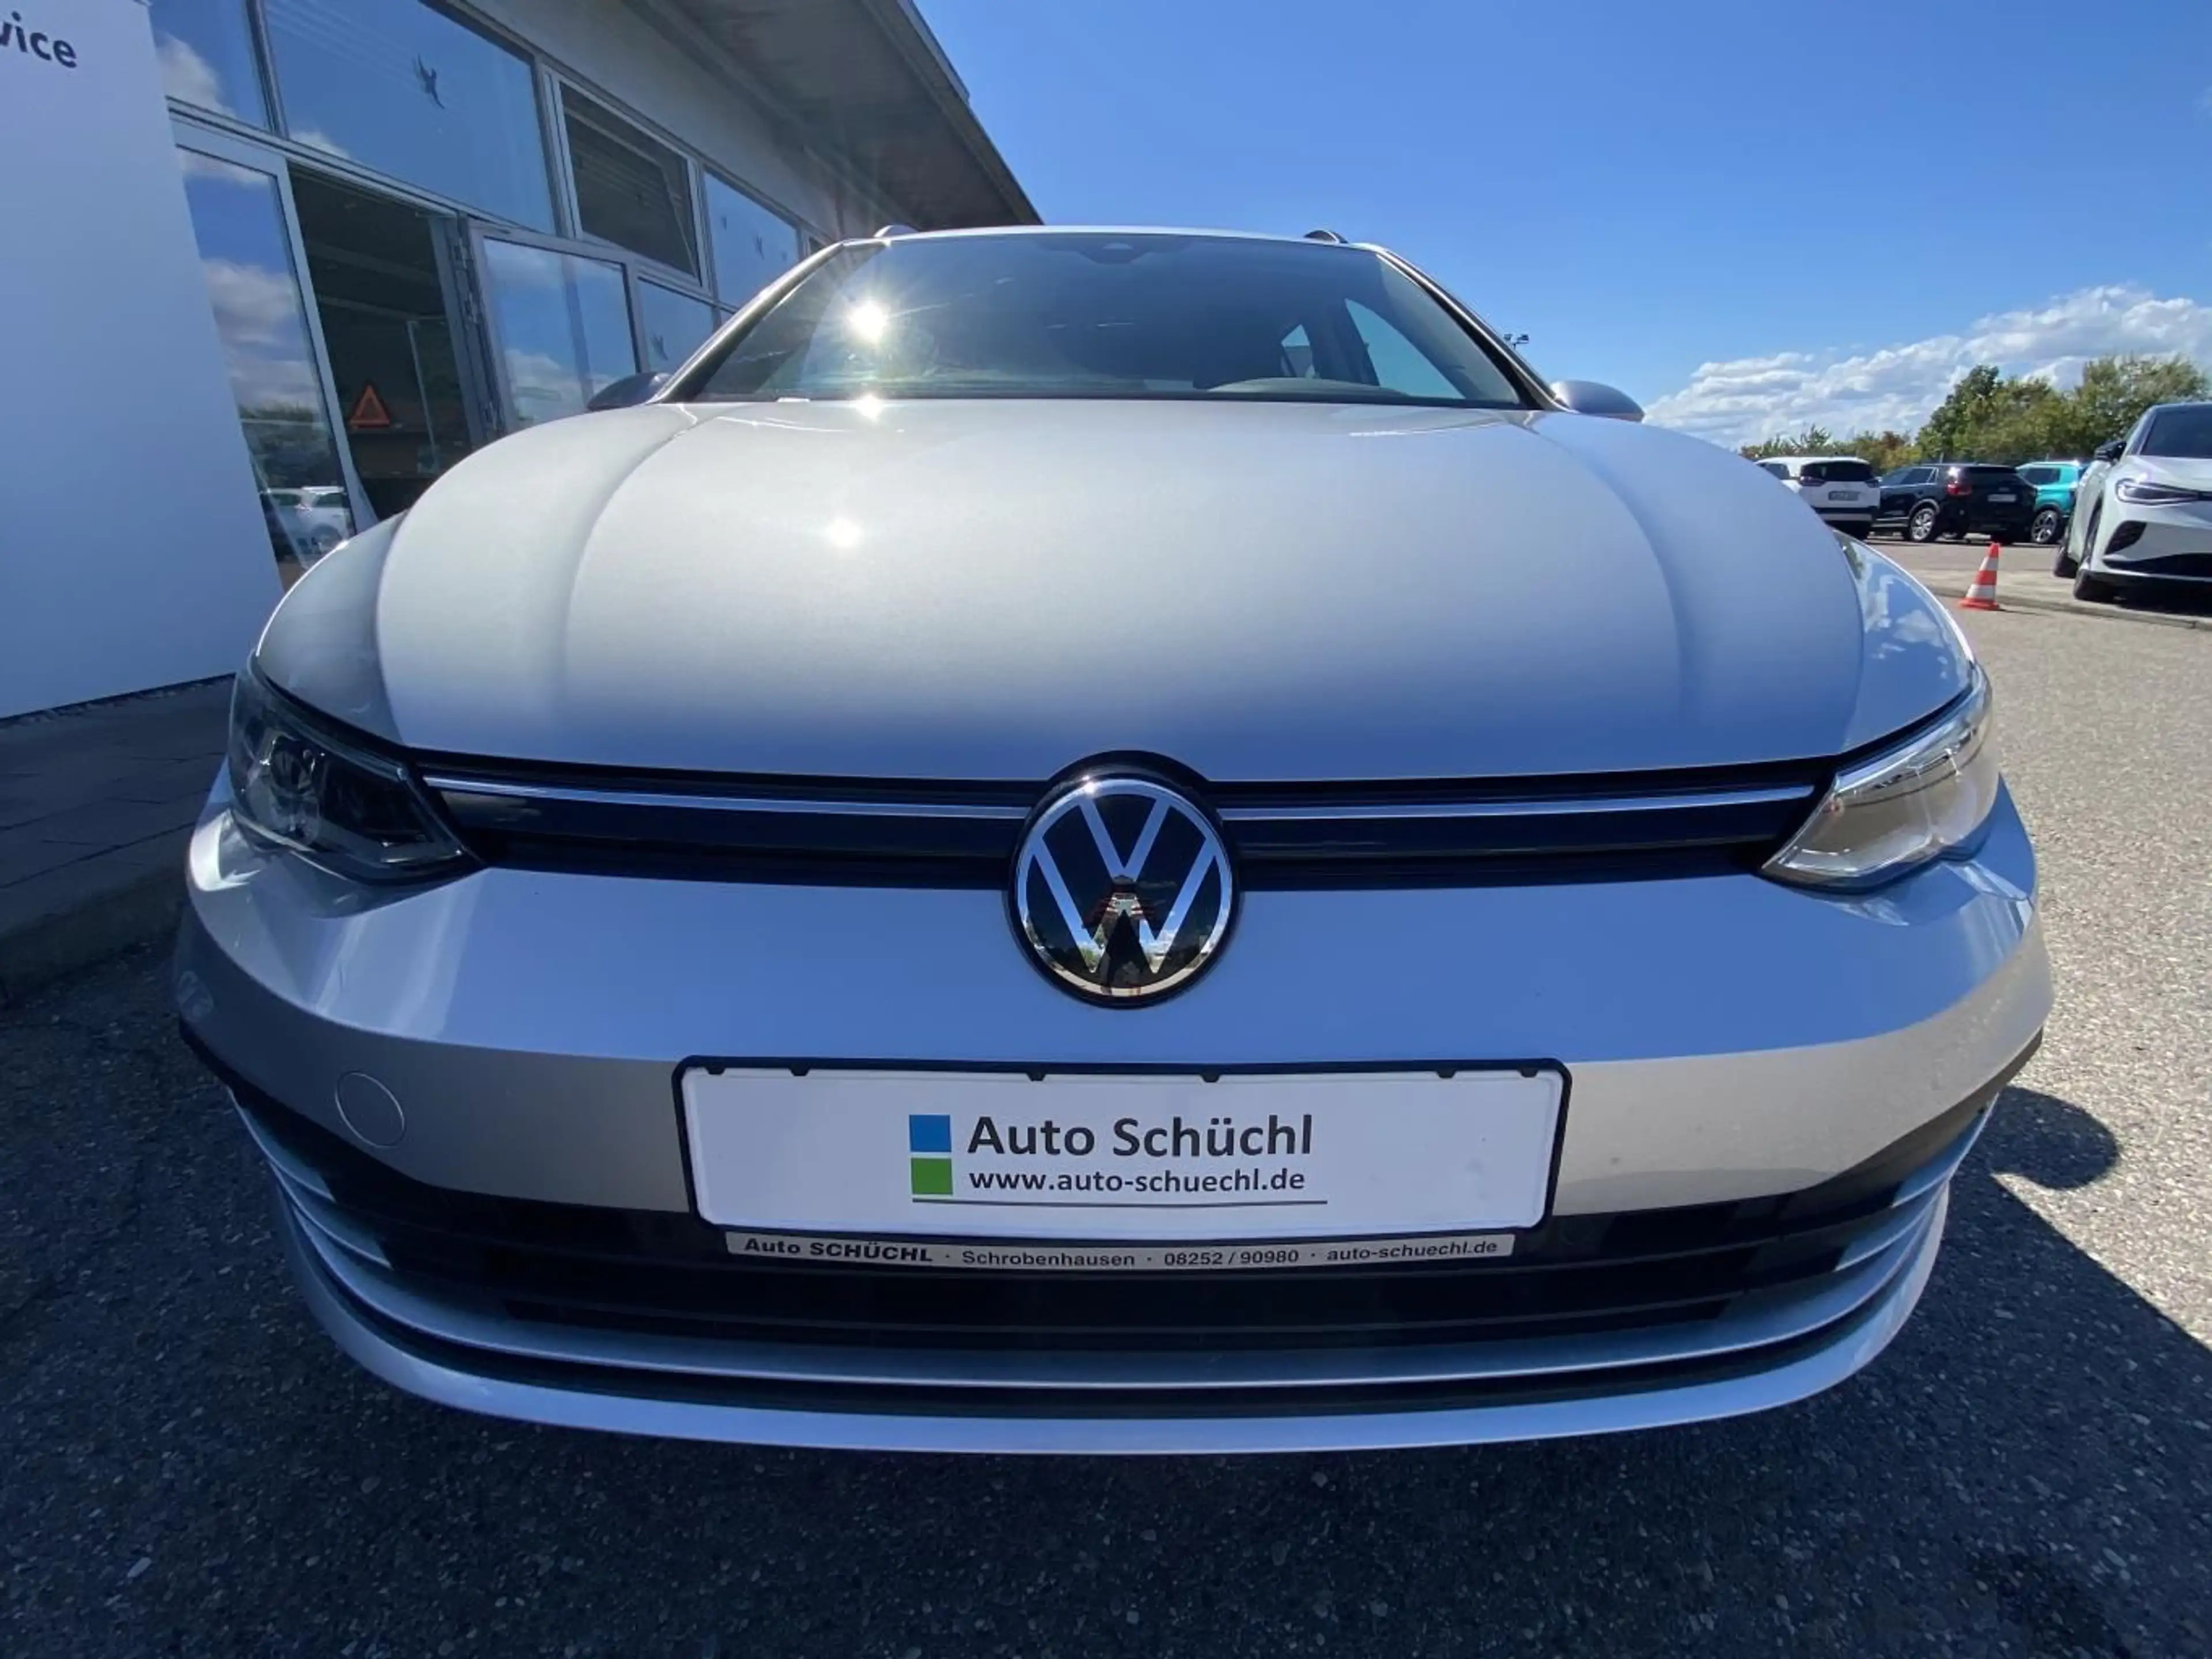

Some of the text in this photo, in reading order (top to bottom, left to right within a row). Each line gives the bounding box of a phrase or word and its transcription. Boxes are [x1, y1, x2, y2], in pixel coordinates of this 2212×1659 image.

[967, 1114, 1312, 1157] Auto Schüchl
[968, 1168, 1304, 1192] www.auto-schuechl.de
[744, 1238, 800, 1253] Auto
[810, 1240, 933, 1262] SCHÜCHL
[962, 1250, 1135, 1266] Schrobenhausen
[1327, 1241, 1498, 1261] auto-schuechl.de
